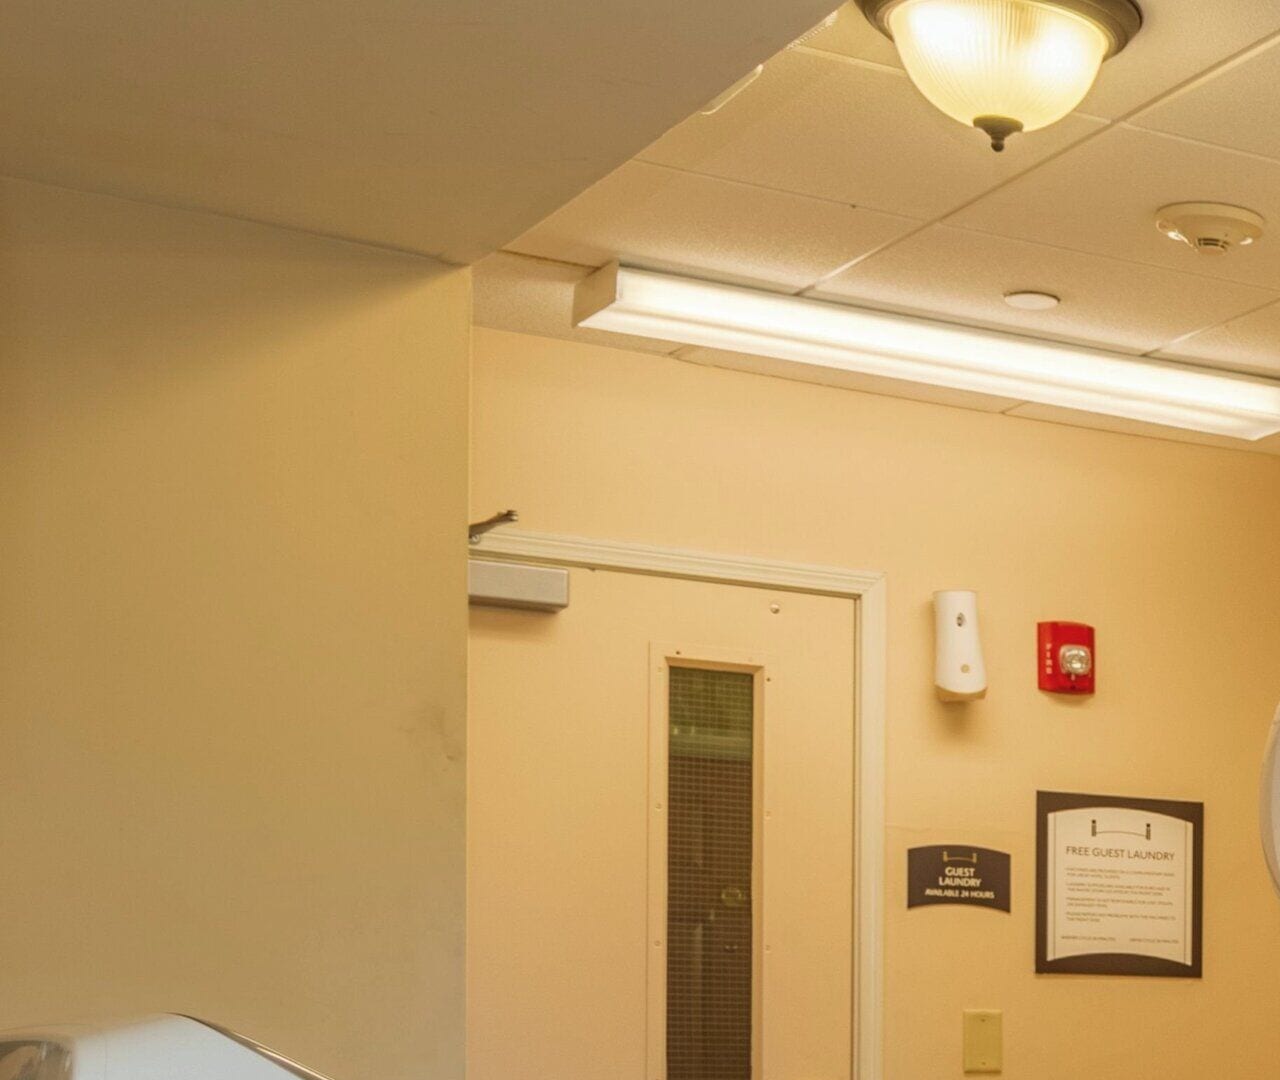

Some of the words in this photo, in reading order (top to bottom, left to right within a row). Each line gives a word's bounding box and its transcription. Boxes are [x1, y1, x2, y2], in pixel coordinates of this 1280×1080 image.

[1066, 846, 1090, 856] FREE
[1092, 847, 1125, 858] GUEST
[1127, 849, 1175, 861] LAUNDRY
[945, 866, 975, 877] GUEST
[938, 876, 982, 887] LAUNDRY
[924, 888, 960, 897] AVAILABLE
[961, 890, 969, 898] 24
[970, 891, 995, 899] HOURS
